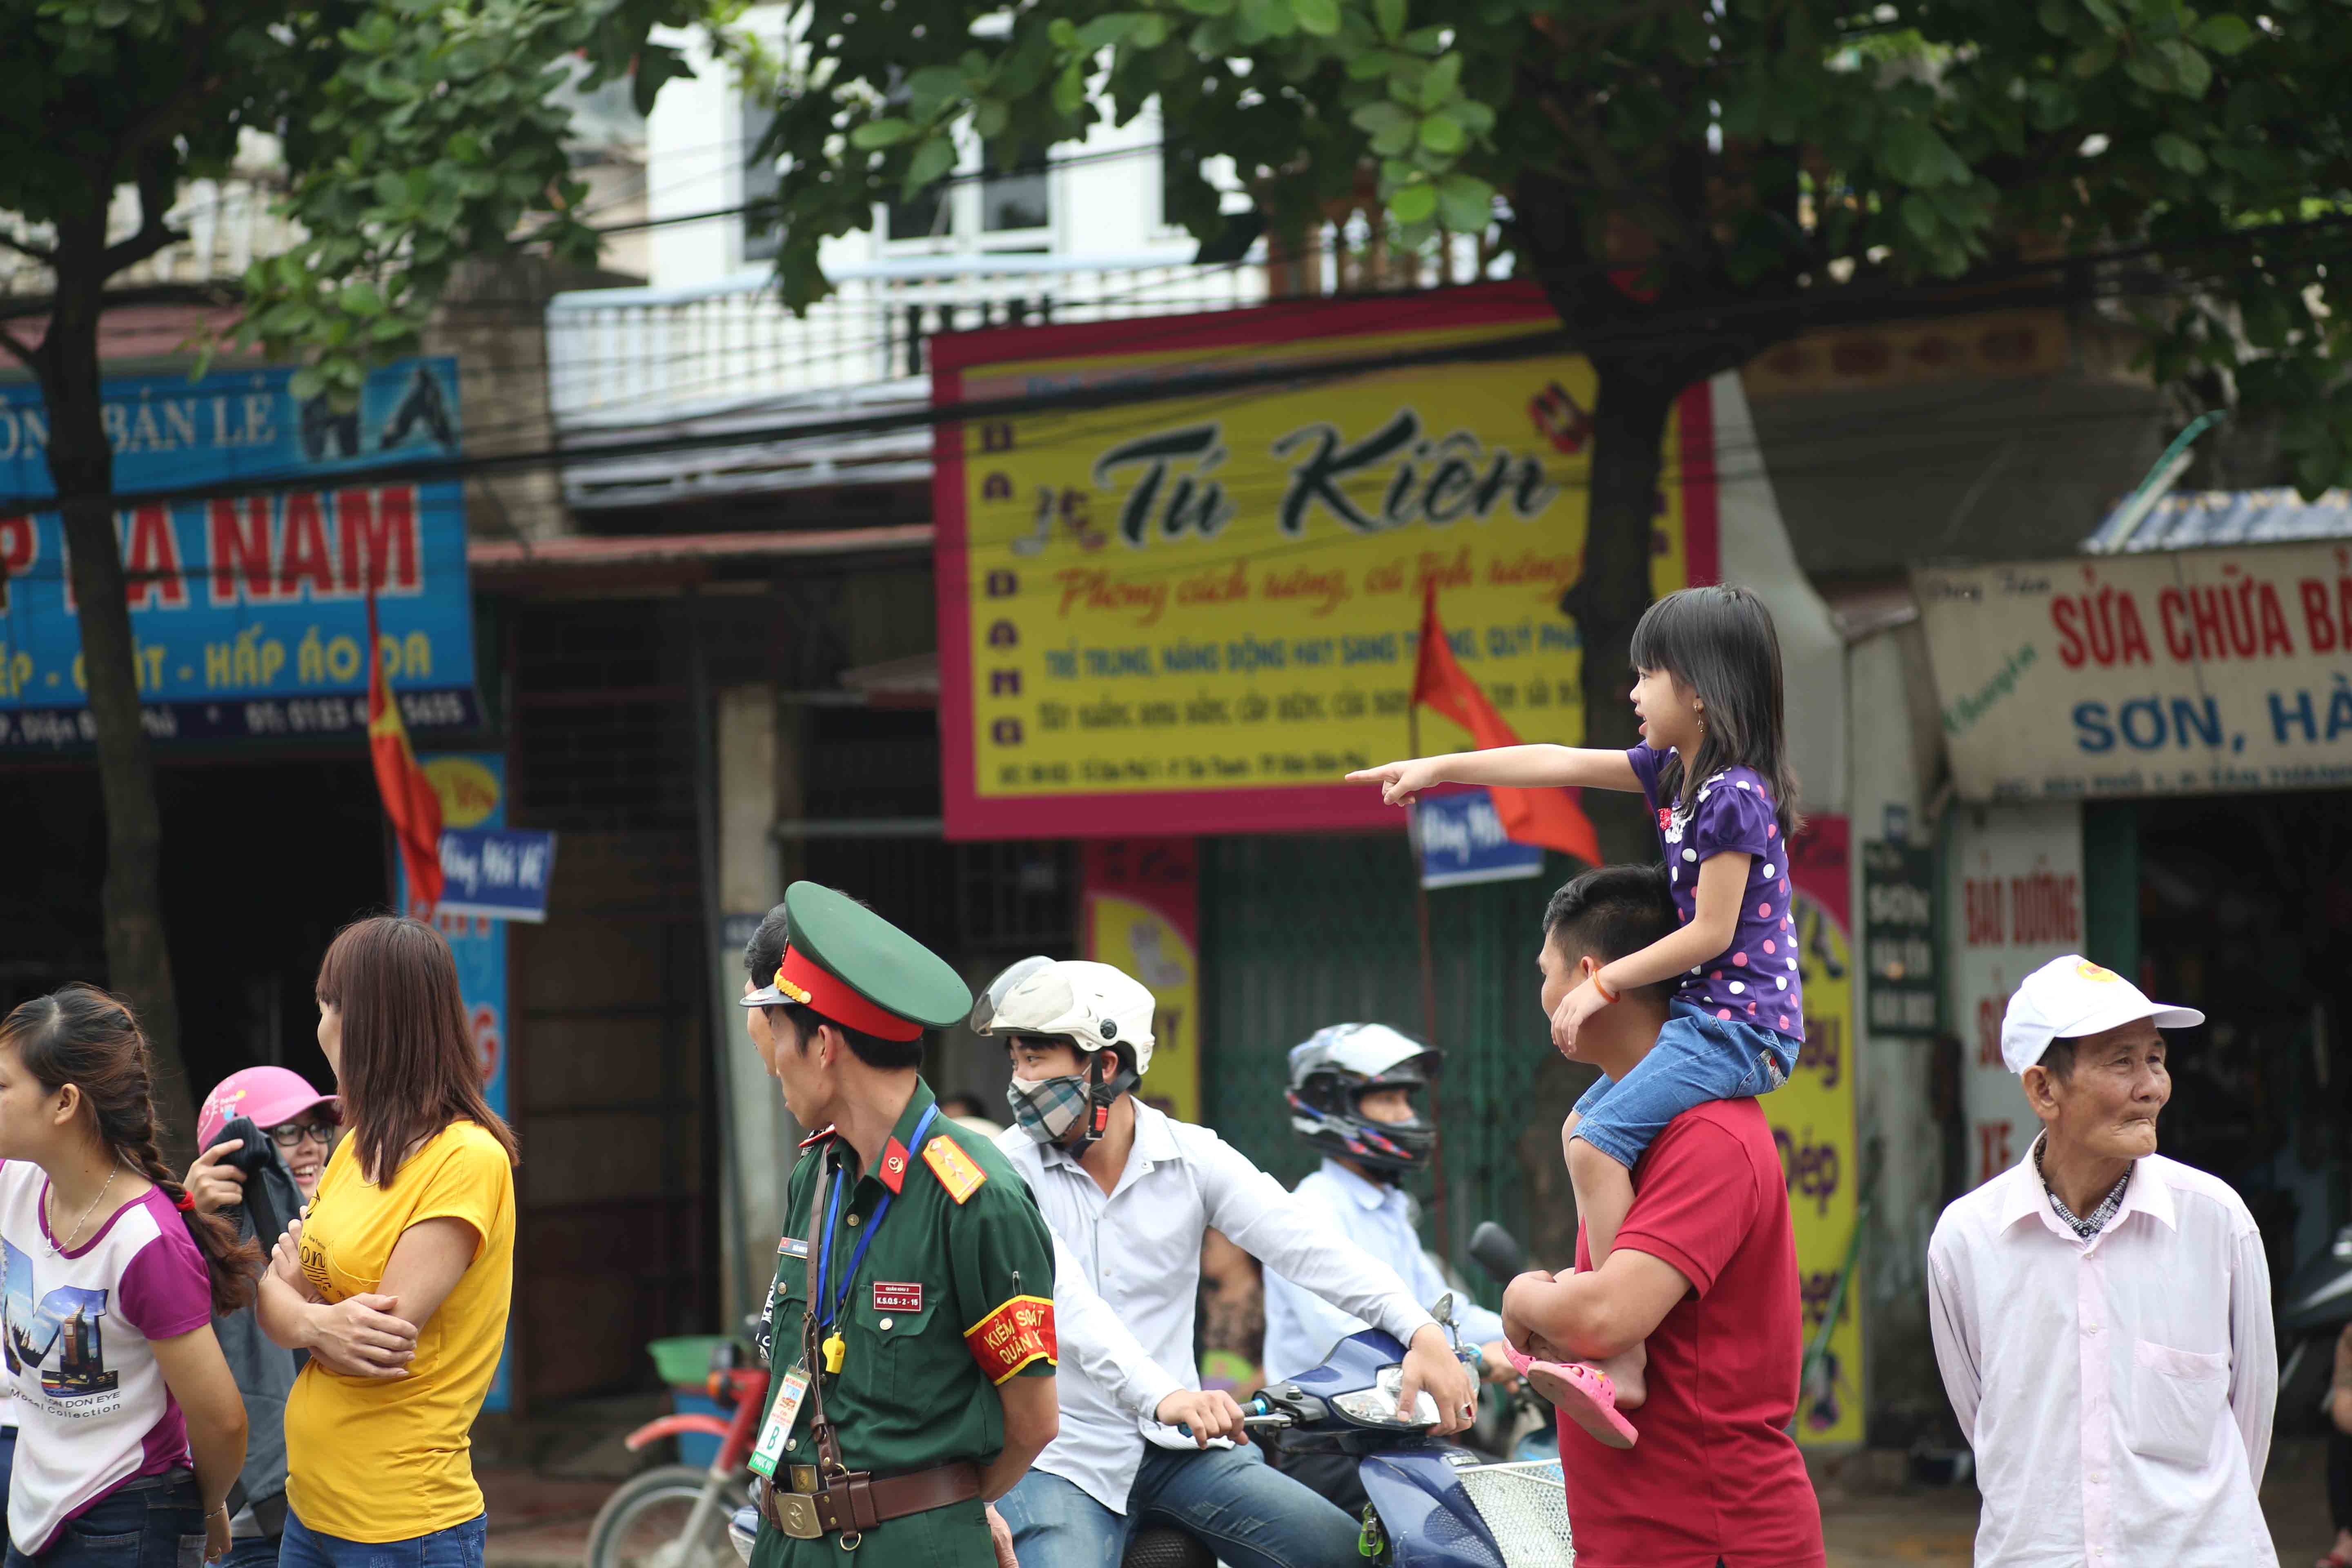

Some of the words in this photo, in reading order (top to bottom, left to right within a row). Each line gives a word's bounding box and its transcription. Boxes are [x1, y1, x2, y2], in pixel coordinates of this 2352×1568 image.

[1094, 422, 1236, 549] Tú
[1271, 408, 1560, 538] Kiên
[206, 487, 423, 608] NAM
[2050, 565, 2152, 671] SỬA
[2158, 562, 2293, 664] CHỮA
[205, 622, 285, 688] HẤP
[298, 626, 360, 683] ÁO
[2072, 694, 2244, 753] SƠN,
[984, 1319, 1015, 1350] KIỂM
[1016, 1304, 1045, 1327] SOÁT
[999, 1333, 1033, 1365] QUÂN
[48, 1403, 120, 1418] Collection
[97, 1391, 120, 1403] EYE
[766, 1425, 780, 1450] B
